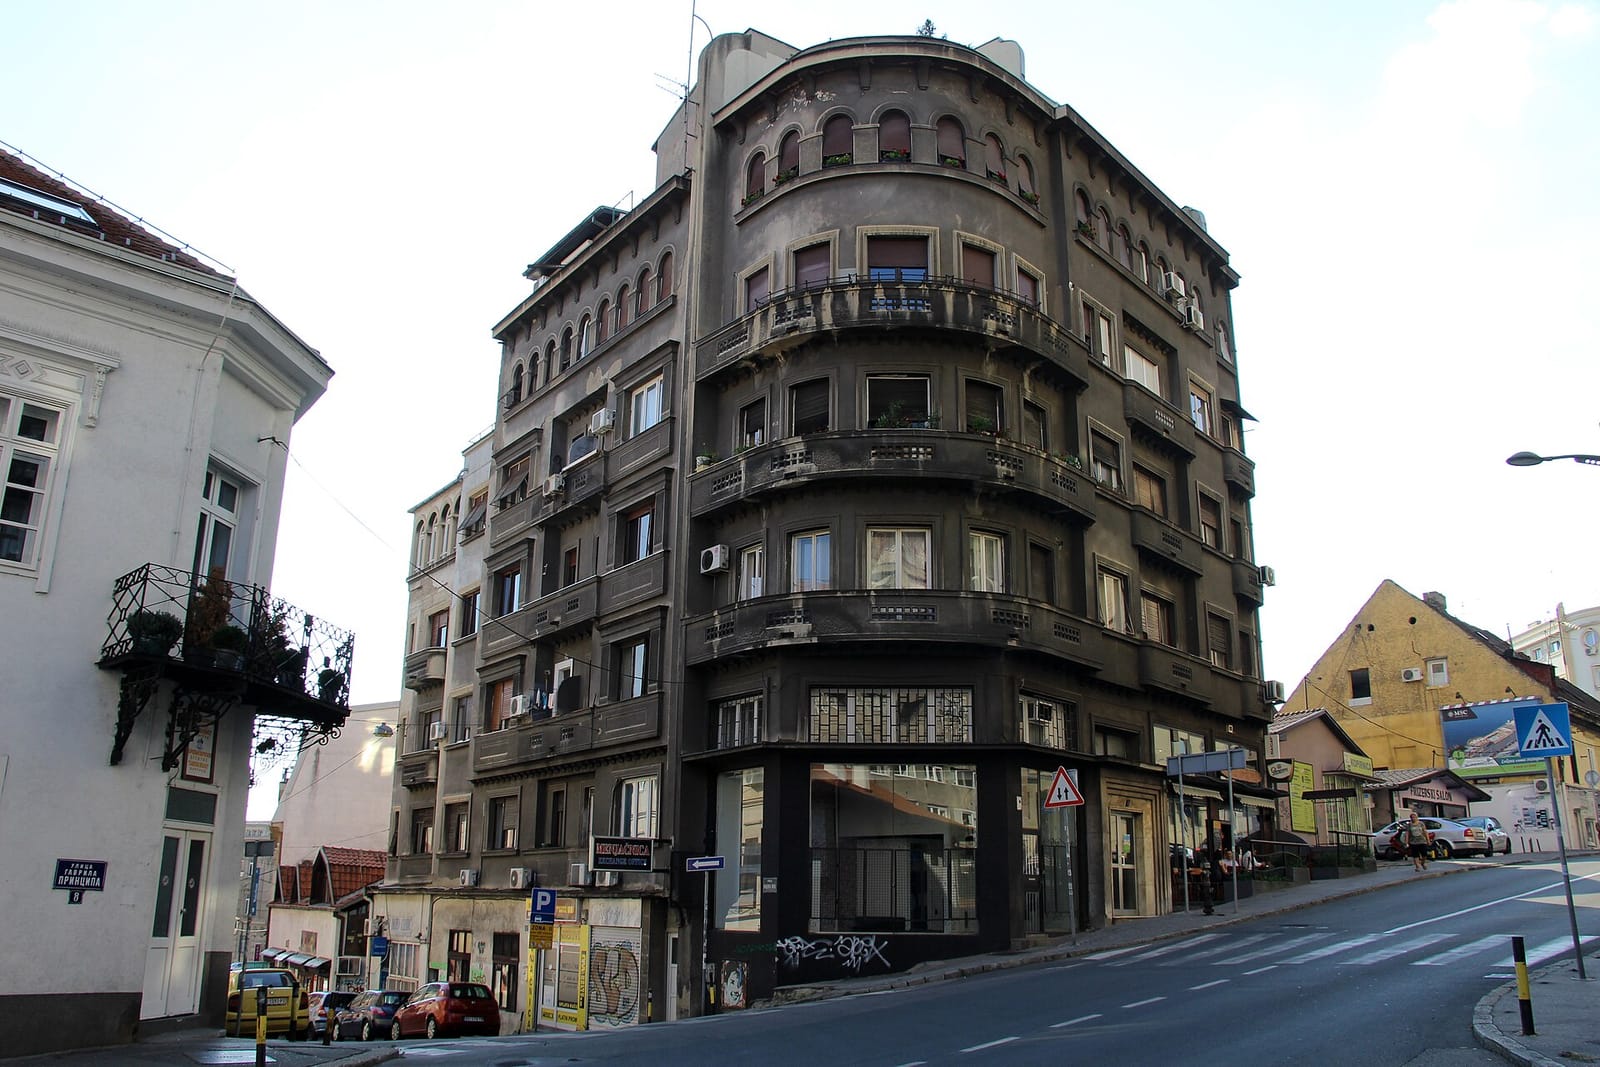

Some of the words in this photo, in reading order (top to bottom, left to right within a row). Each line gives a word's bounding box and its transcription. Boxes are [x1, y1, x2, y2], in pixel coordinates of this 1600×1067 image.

[1435, 788, 1452, 801] SALON
[58, 876, 101, 886] ПРИНЦИПА
[73, 892, 80, 902] 8
[536, 891, 551, 911] P
